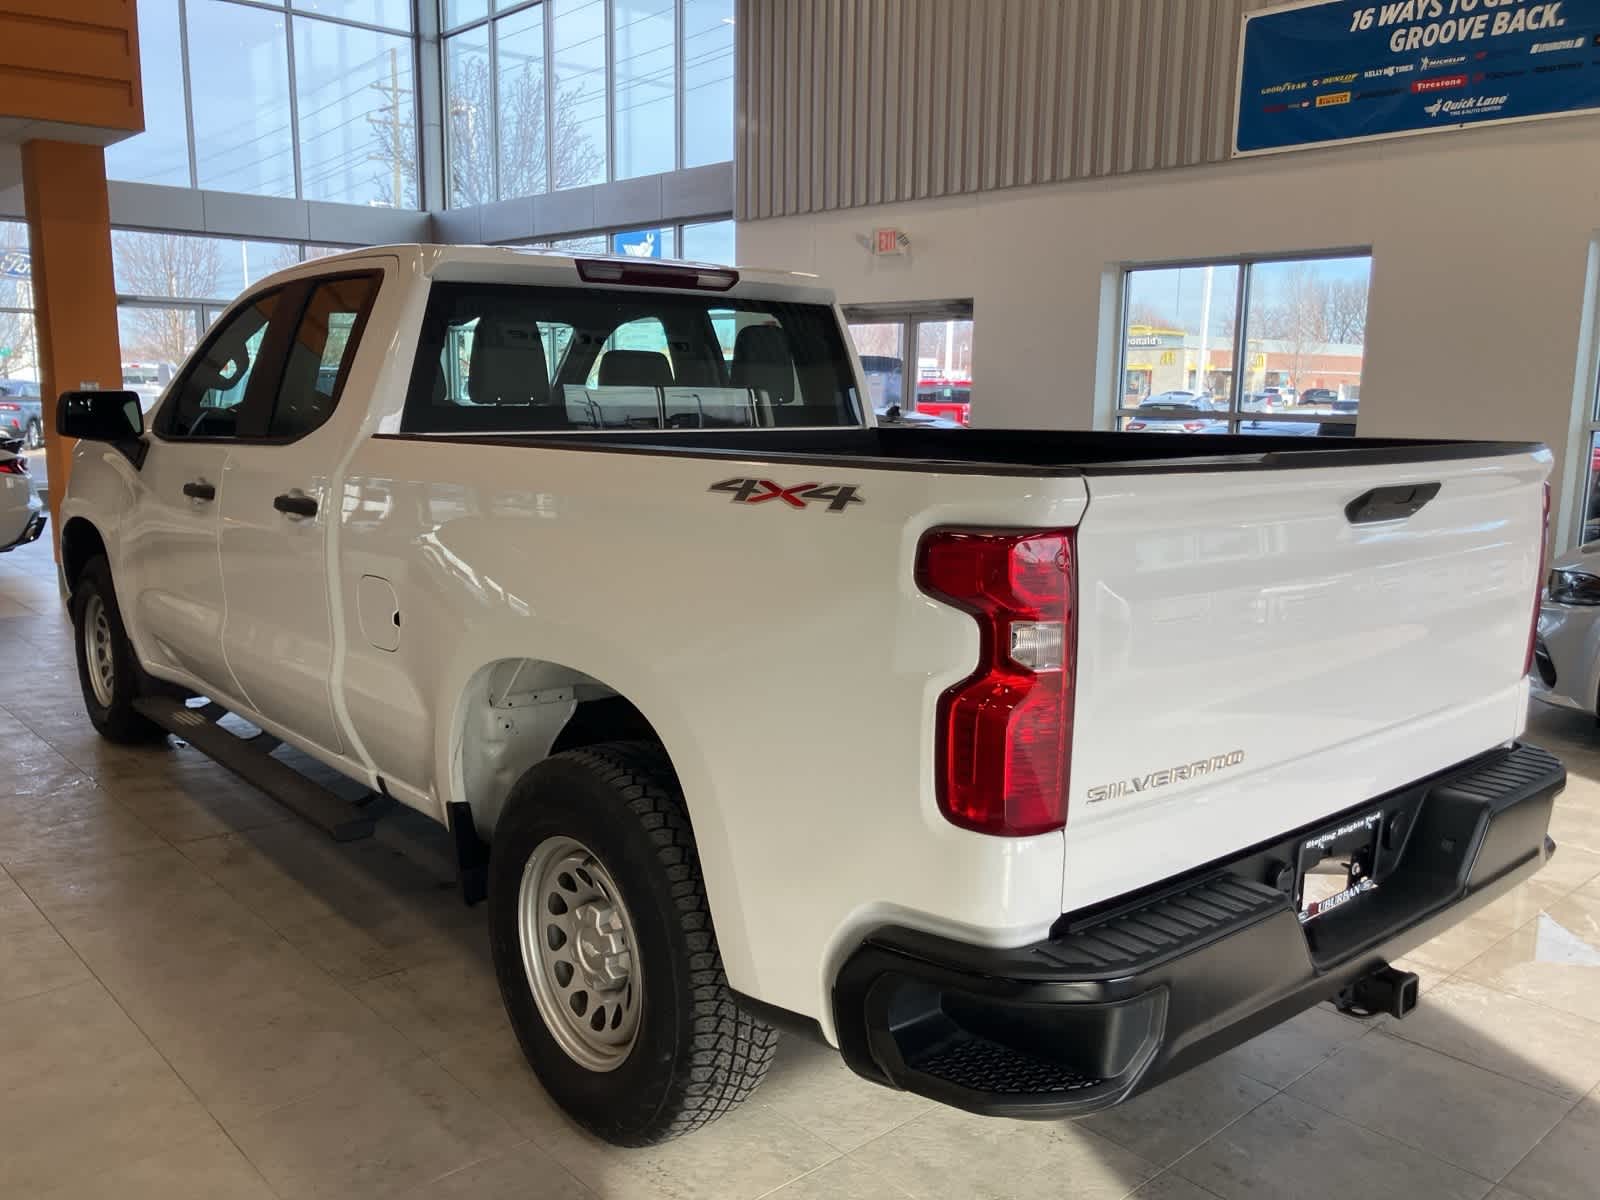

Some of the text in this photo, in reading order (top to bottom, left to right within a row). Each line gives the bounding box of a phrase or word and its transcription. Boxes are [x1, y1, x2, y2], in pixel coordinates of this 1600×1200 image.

[1350, 8, 1375, 32] 16
[1378, 0, 1443, 26] WAYS
[1390, 14, 1488, 52] GROOVE
[1491, 3, 1566, 36] BACK.
[1417, 79, 1462, 92] Firestone
[1442, 95, 1507, 112] Quick Lane
[1086, 750, 1245, 804] SILVERADO
